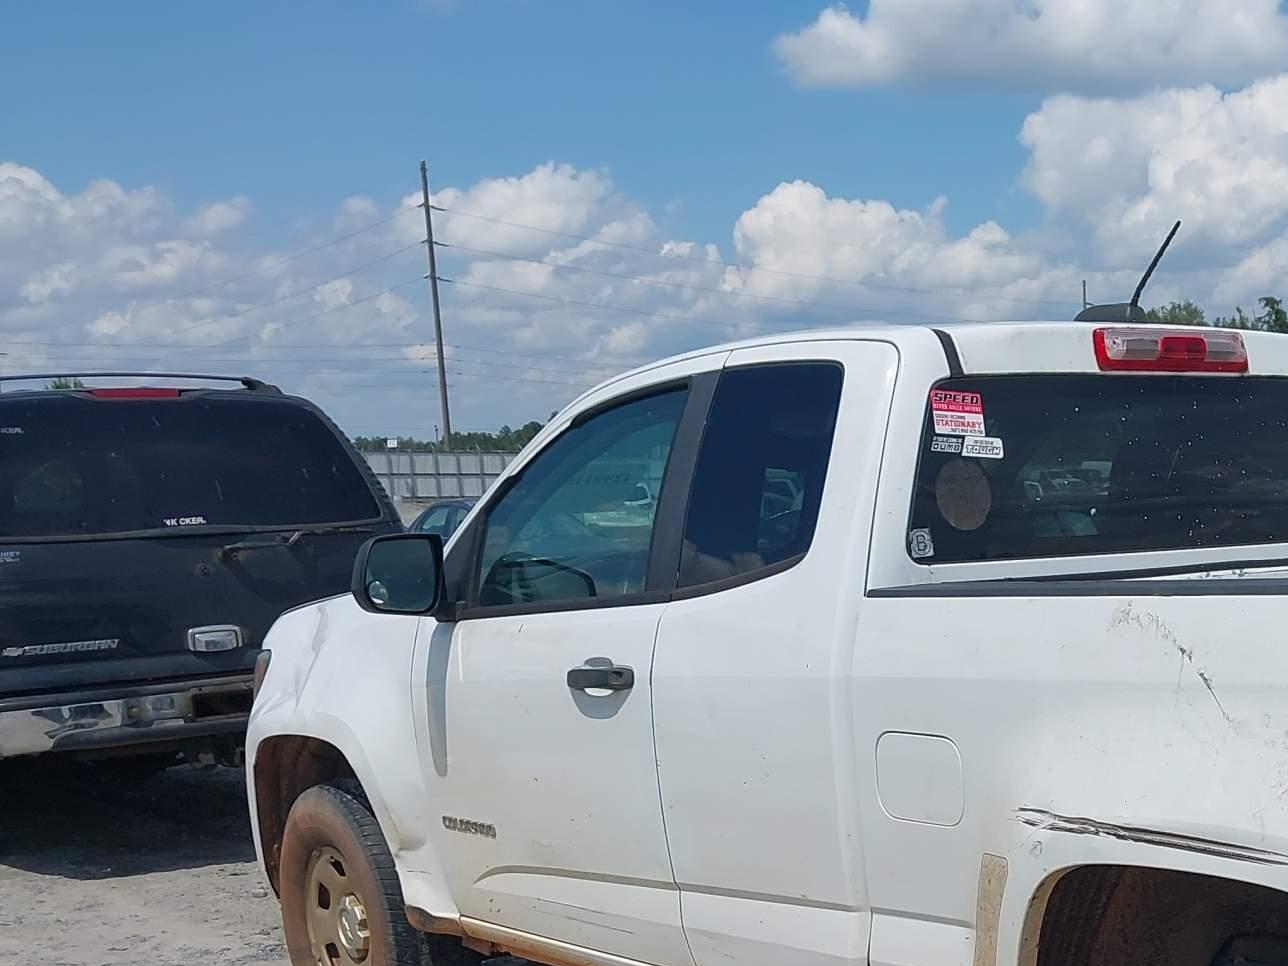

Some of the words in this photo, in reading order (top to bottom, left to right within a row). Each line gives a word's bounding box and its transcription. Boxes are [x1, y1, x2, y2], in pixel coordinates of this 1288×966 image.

[934, 392, 979, 405] SPEED
[966, 445, 1001, 456] TOUGH
[24, 638, 120, 656] SUBURBAN
